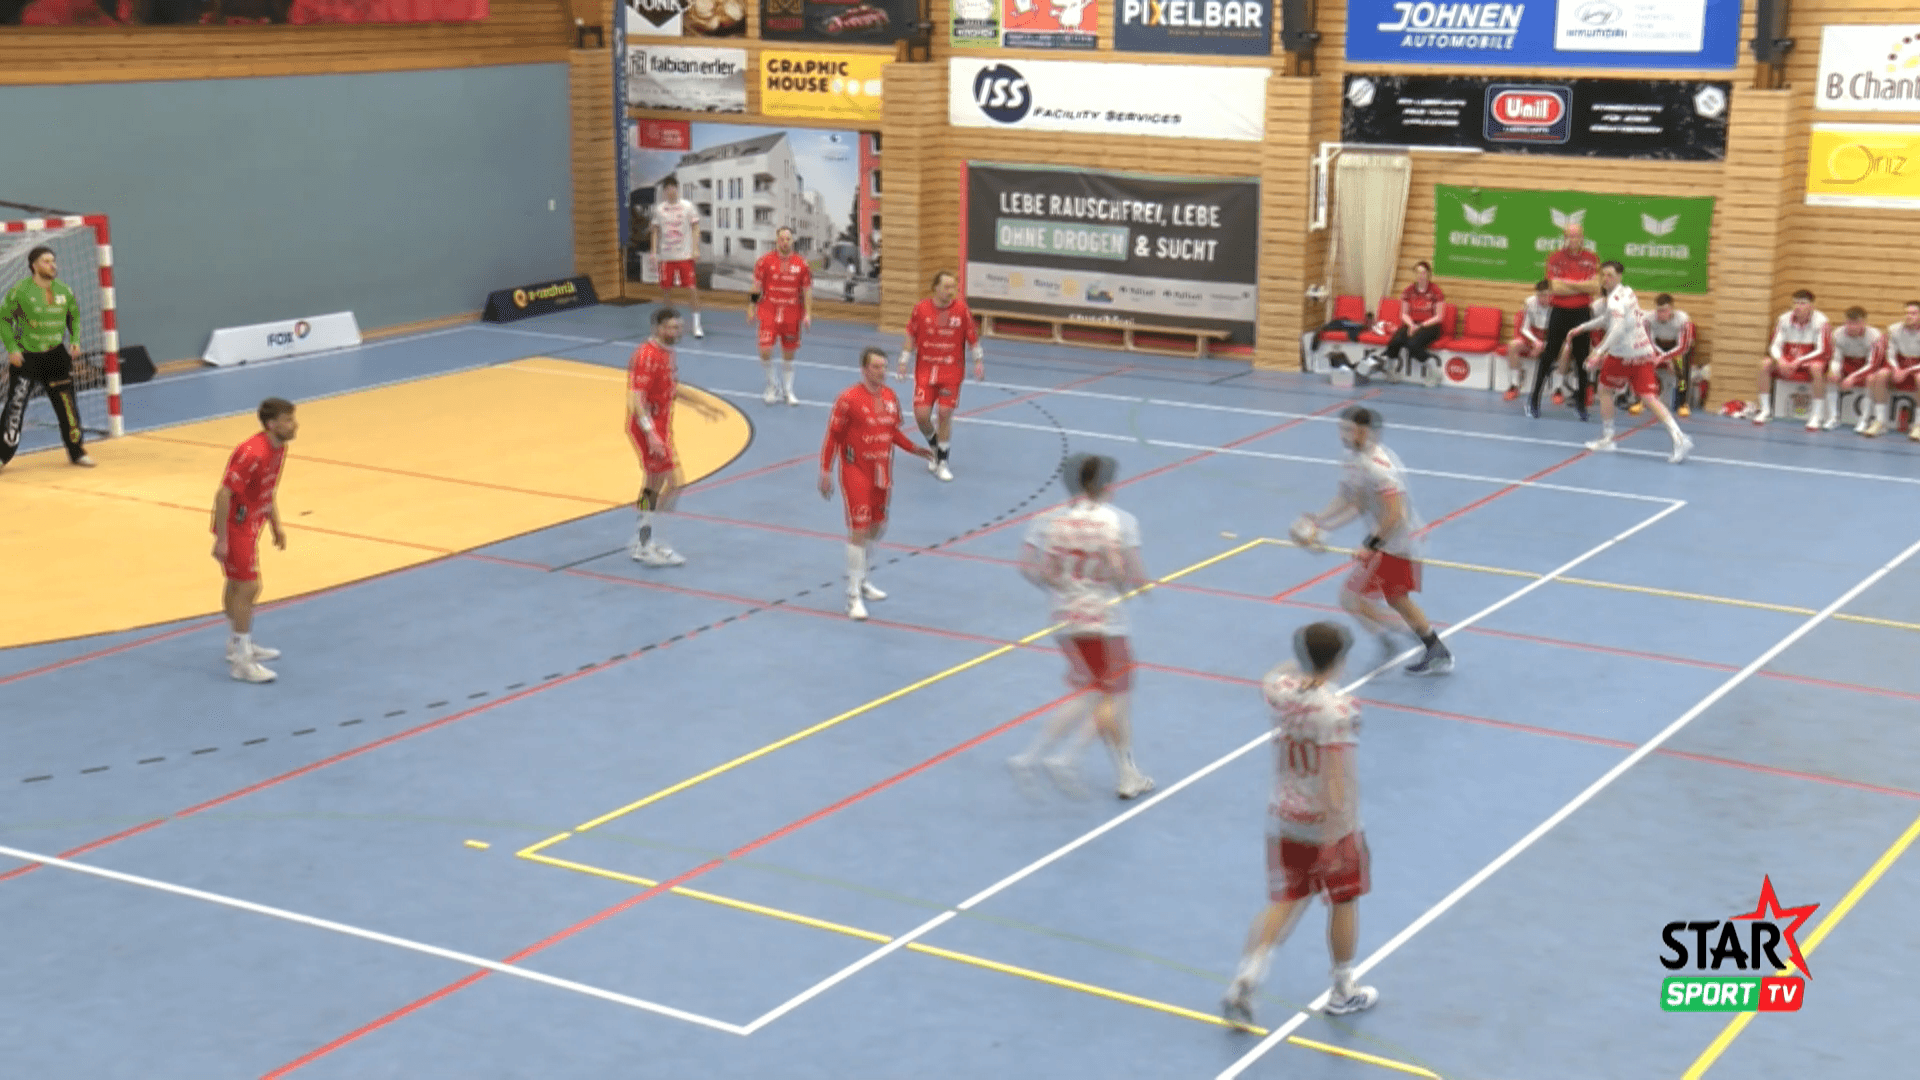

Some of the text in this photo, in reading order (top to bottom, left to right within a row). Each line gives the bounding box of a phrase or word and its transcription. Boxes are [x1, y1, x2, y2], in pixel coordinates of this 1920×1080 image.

[1122, 0, 1263, 28] PIXELBAR
[1377, 2, 1525, 32] JOHNEN
[1401, 34, 1515, 49] AUTOMOBILE
[766, 58, 849, 77] GRAPHIC
[767, 76, 829, 93] HOUSE
[976, 77, 1026, 108] ISS
[1826, 72, 1844, 100] B
[1033, 106, 1182, 125] FACILITY SERVICES
[1001, 191, 1222, 228] LEBE RAUSCHFREI, LEBE
[1000, 225, 1218, 262] OHNE DROGEN & SUCHT
[1449, 231, 1508, 249] erima
[1535, 236, 1597, 252] eria
[1624, 243, 1690, 259] erima
